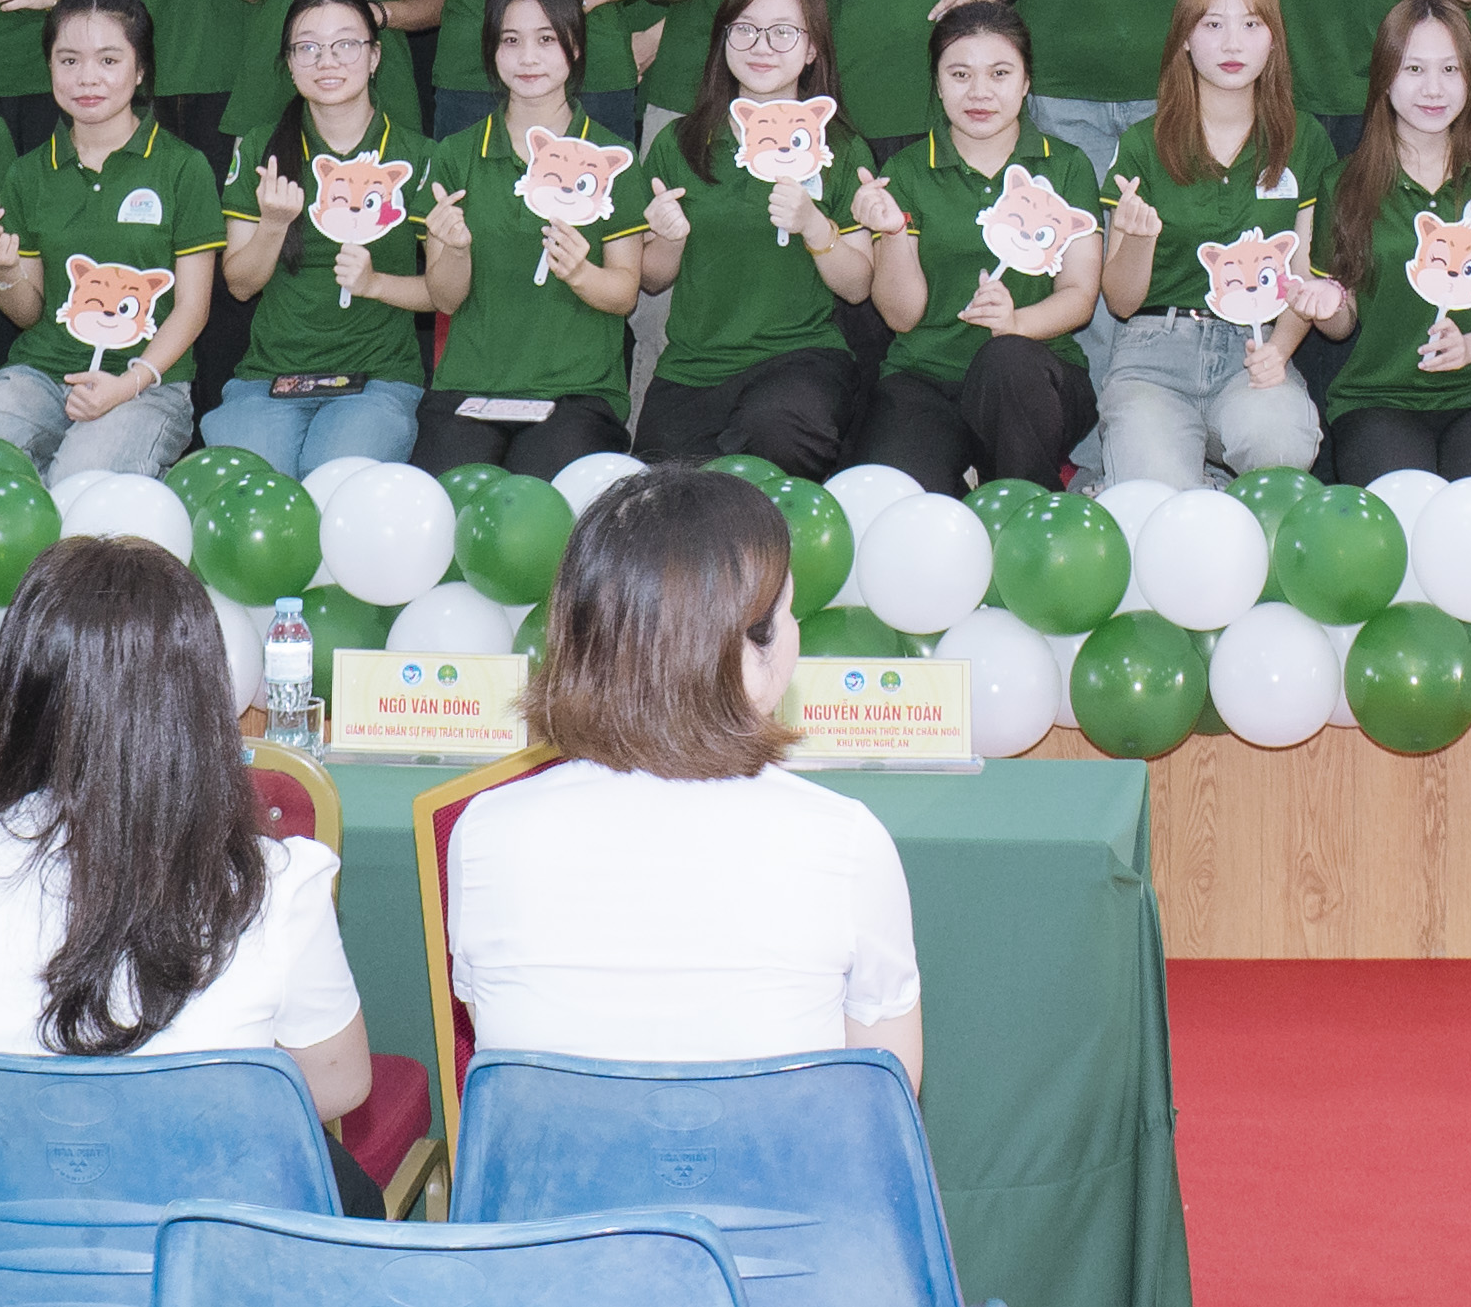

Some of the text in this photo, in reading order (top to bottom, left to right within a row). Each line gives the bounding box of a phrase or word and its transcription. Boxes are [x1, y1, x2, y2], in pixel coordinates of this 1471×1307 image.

[411, 694, 439, 715] VĂN
[803, 697, 942, 722] NGUYỄN XUÂN TOÀN
[836, 739, 853, 748] KHU
